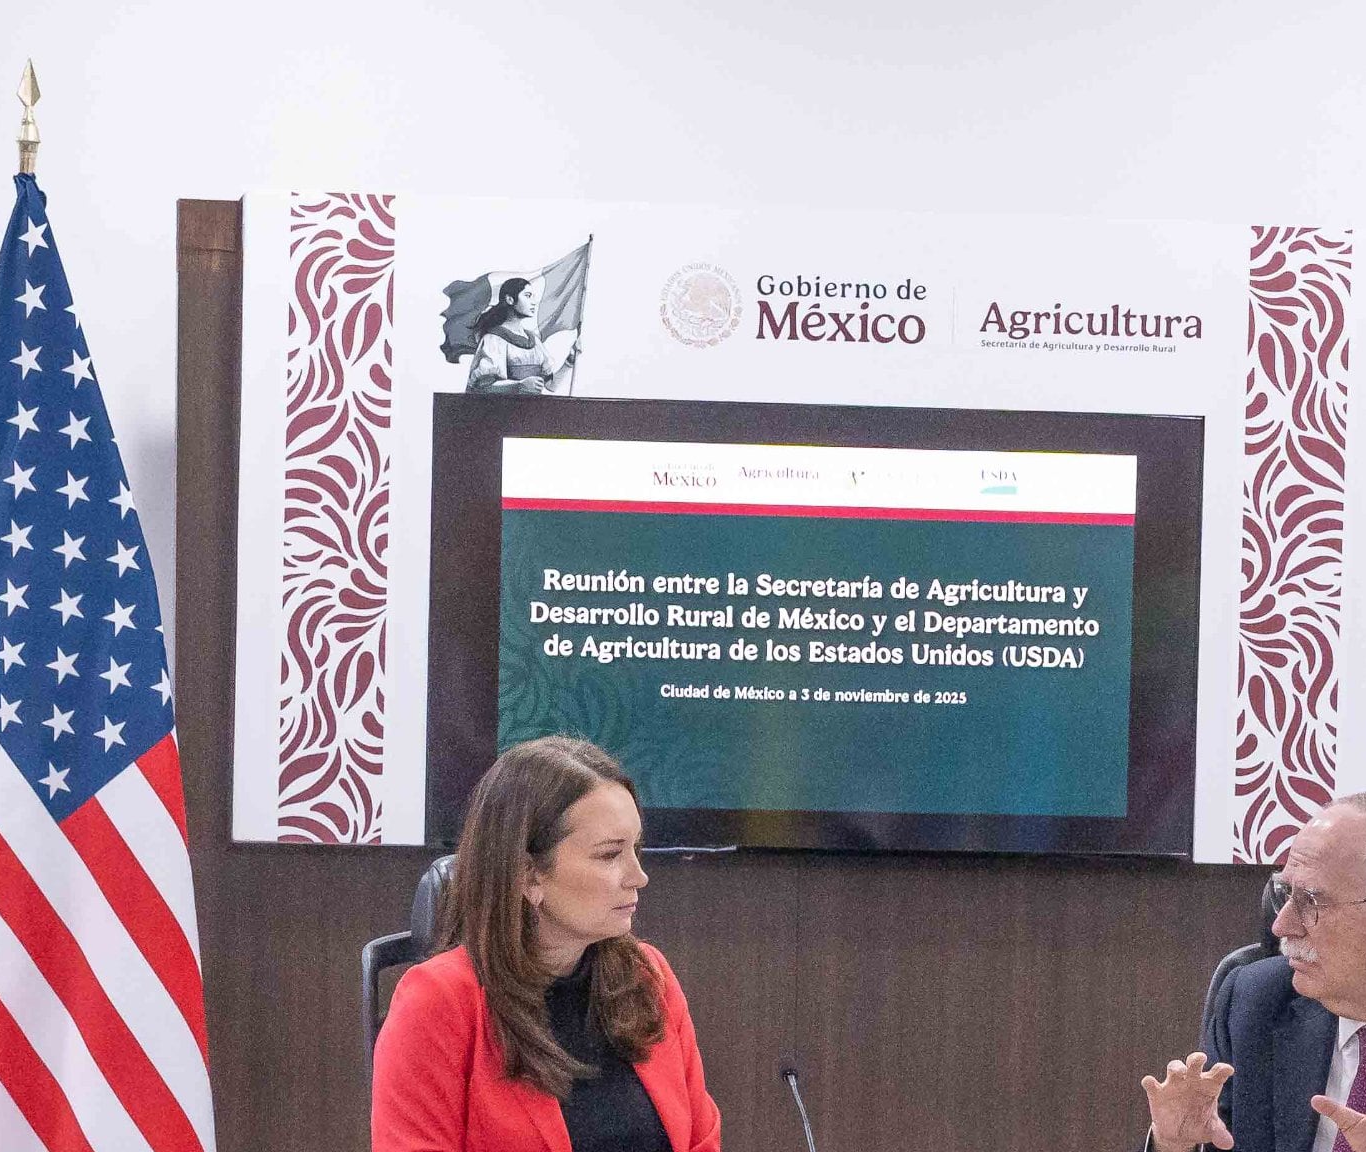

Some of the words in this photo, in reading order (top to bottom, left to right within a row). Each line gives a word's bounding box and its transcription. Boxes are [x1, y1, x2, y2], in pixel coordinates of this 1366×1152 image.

[756, 274, 888, 300] Gobierno
[896, 278, 927, 301] de
[755, 300, 926, 345] México
[979, 301, 1202, 341] Agricultura
[1030, 341, 1039, 349] de
[1043, 342, 1093, 351] Agricultura
[1104, 344, 1149, 352] Desarrollo
[543, 568, 645, 593] Reunión
[652, 573, 720, 595] entre
[726, 572, 749, 596] la
[755, 573, 883, 599] Secretaría
[890, 576, 920, 600] de
[926, 578, 1066, 607] Agricultura
[1072, 587, 1089, 610] y
[529, 601, 660, 626] Desarrollo
[666, 604, 734, 628] Rural
[741, 605, 771, 629] de
[777, 606, 865, 631] México
[871, 614, 888, 637] y
[894, 609, 916, 633] el
[923, 611, 1100, 639] Departamento
[543, 633, 574, 657] de
[580, 635, 721, 664] Agricultura
[728, 637, 759, 661] de
[765, 638, 802, 662] los
[808, 641, 904, 665] Estados
[911, 643, 994, 667] Unidos
[1002, 645, 1085, 669] (USDA)
[660, 683, 710, 699] Ciudad
[712, 684, 731, 699] de
[734, 685, 786, 701] México
[788, 689, 797, 701] a
[800, 688, 810, 701] 3
[813, 687, 831, 702] de
[834, 688, 910, 703] noviembre
[914, 689, 931, 704] de
[934, 691, 967, 705] 2025
